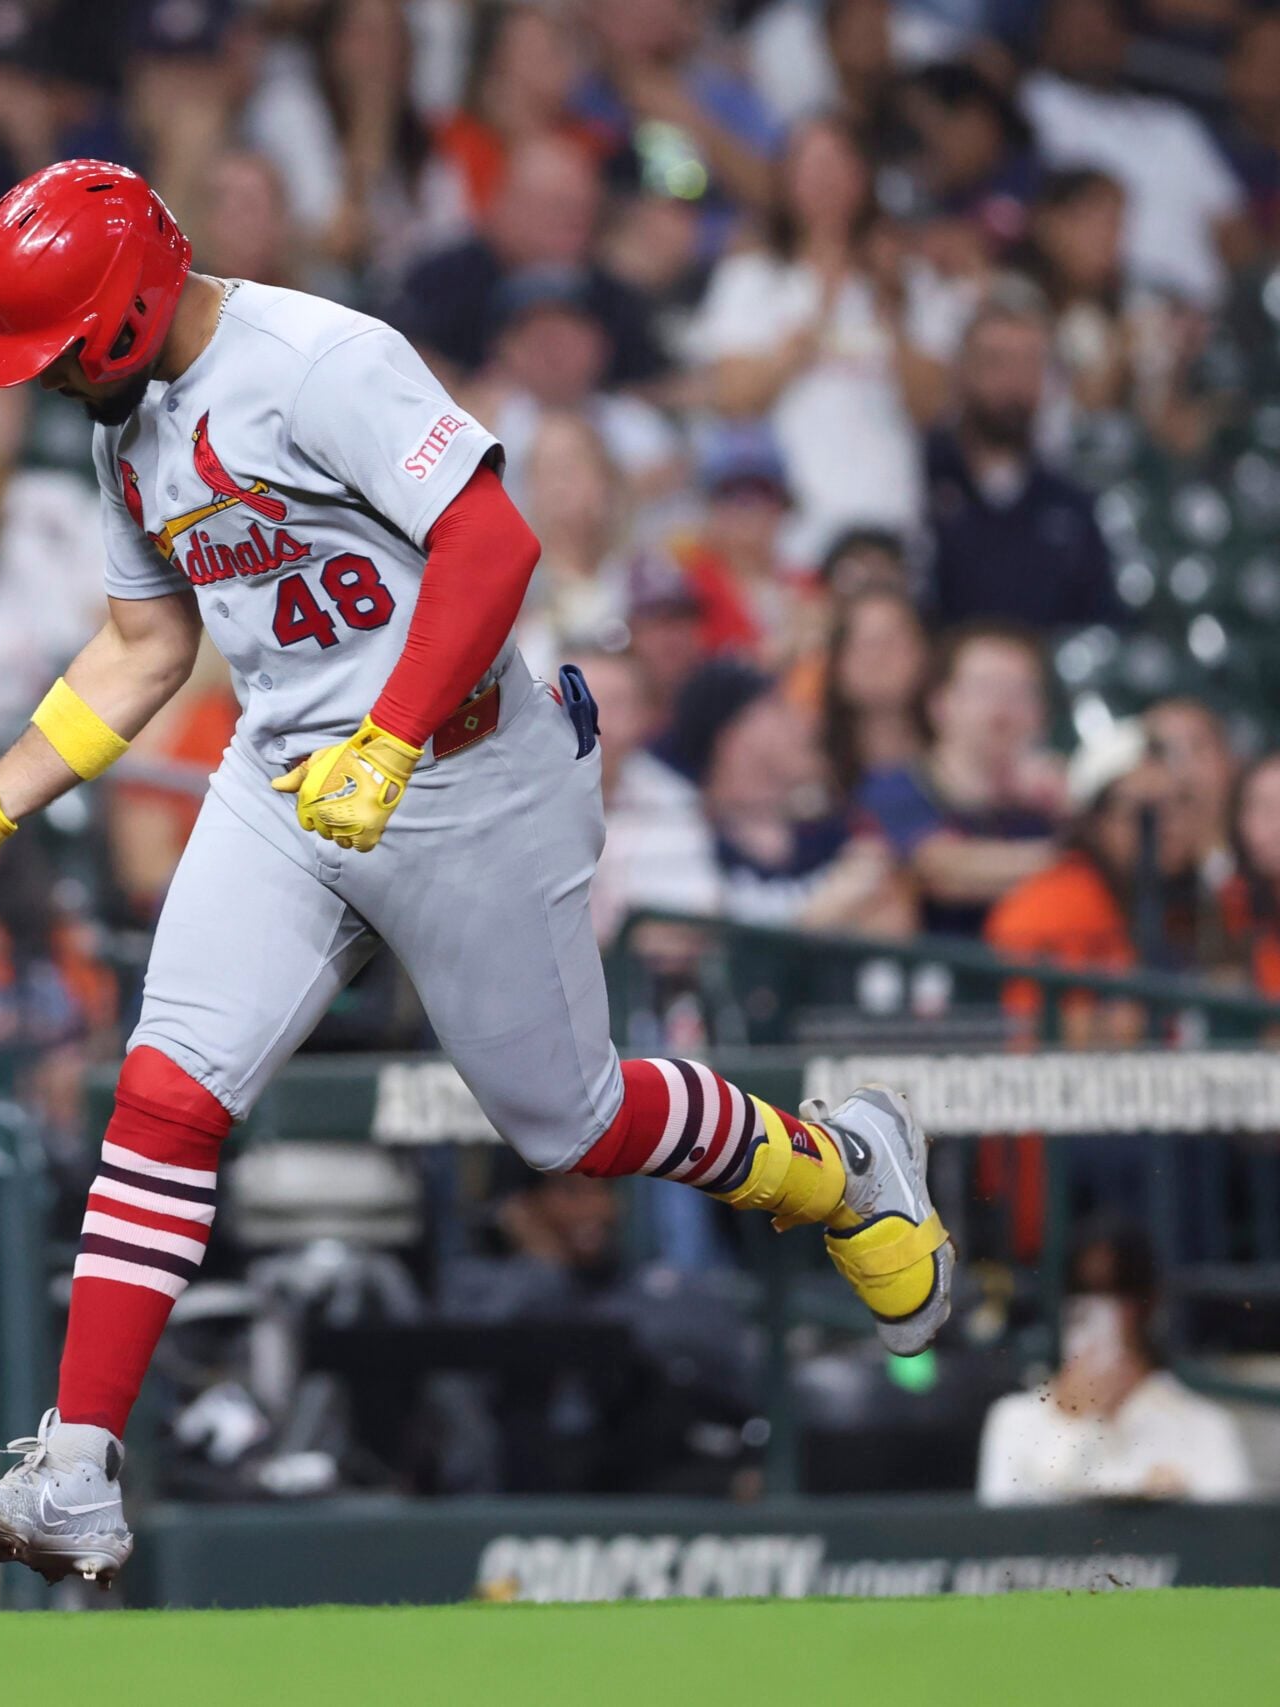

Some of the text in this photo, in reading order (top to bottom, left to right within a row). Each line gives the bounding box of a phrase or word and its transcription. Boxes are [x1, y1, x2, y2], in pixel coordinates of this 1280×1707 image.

[404, 413, 468, 480] STIFEL
[186, 522, 313, 587] dinals
[271, 552, 397, 650] 48
